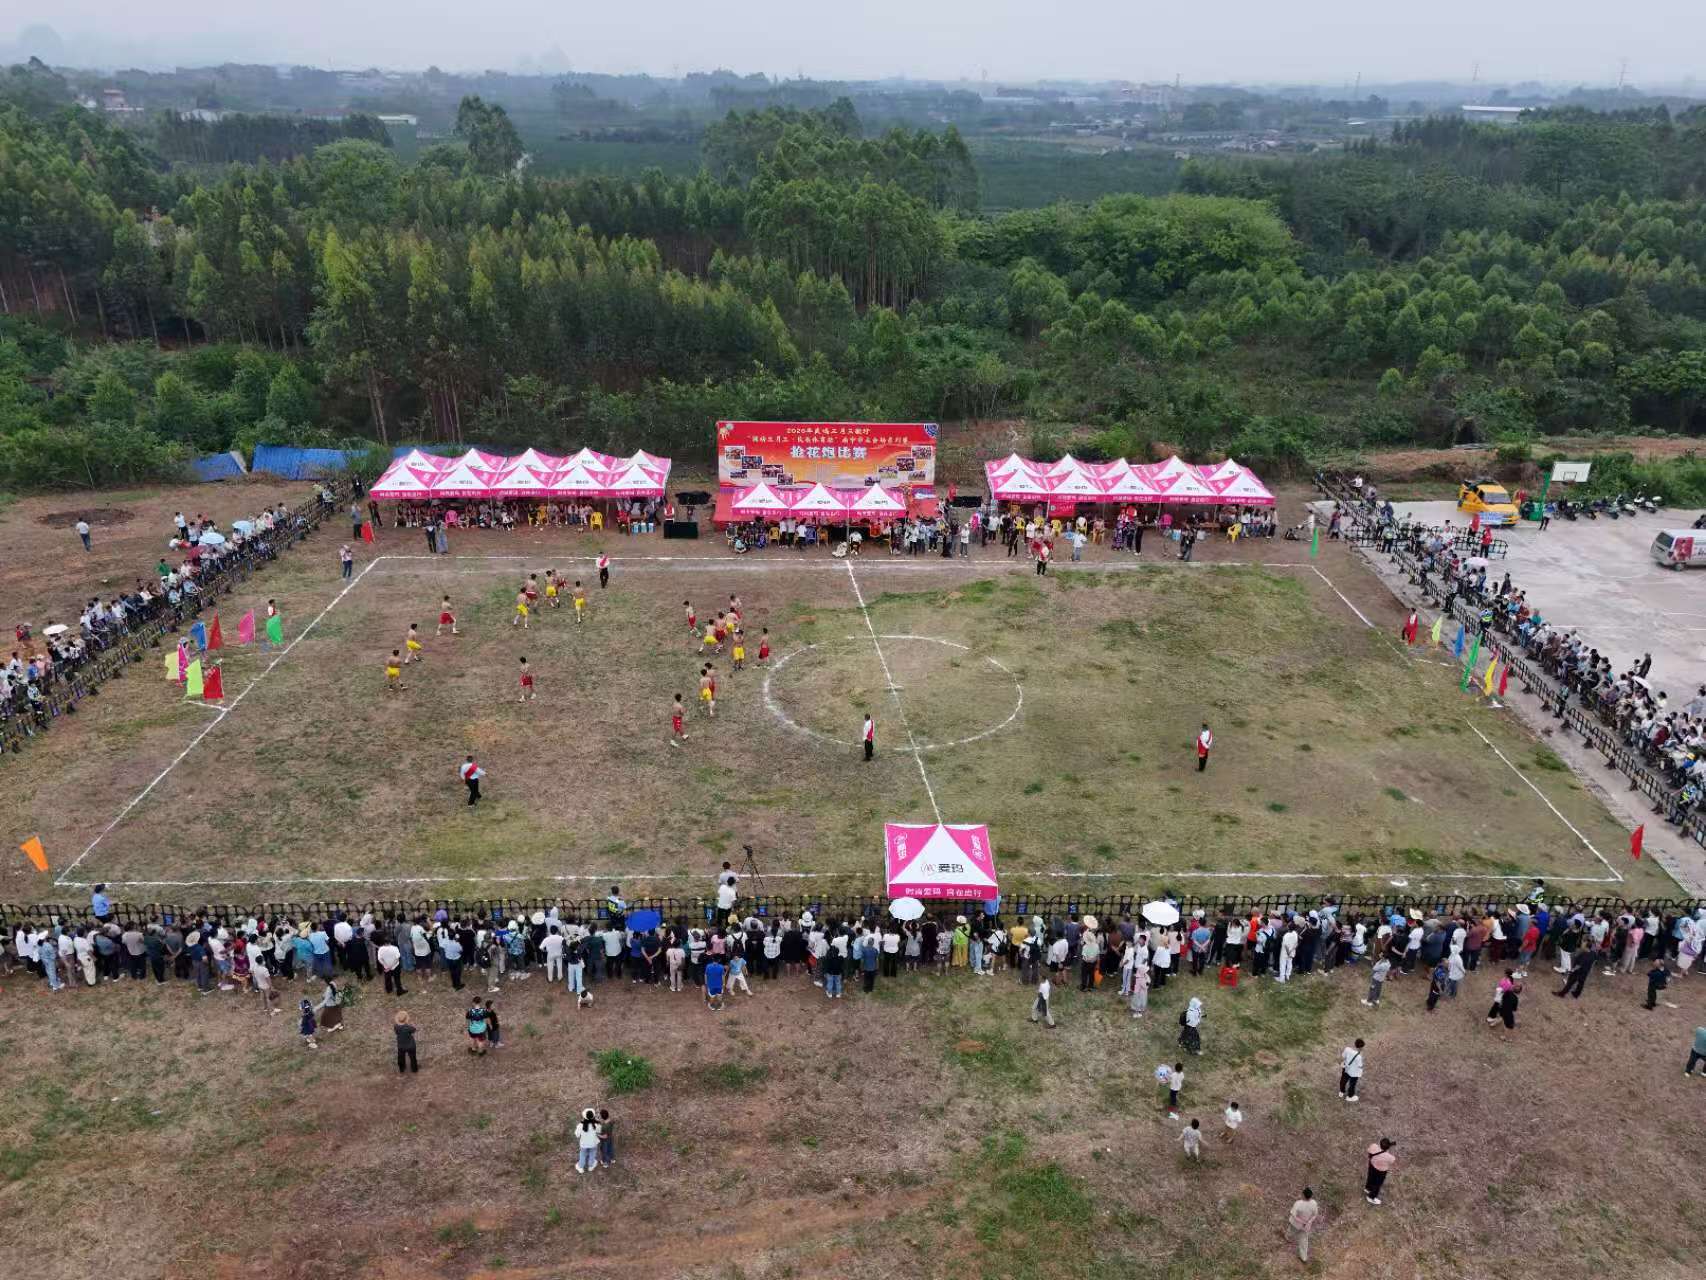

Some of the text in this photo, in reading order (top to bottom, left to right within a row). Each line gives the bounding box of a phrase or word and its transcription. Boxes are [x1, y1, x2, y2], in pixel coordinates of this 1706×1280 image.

[937, 863, 964, 873] 爱玛
[905, 887, 941, 896] 时尚爱玛
